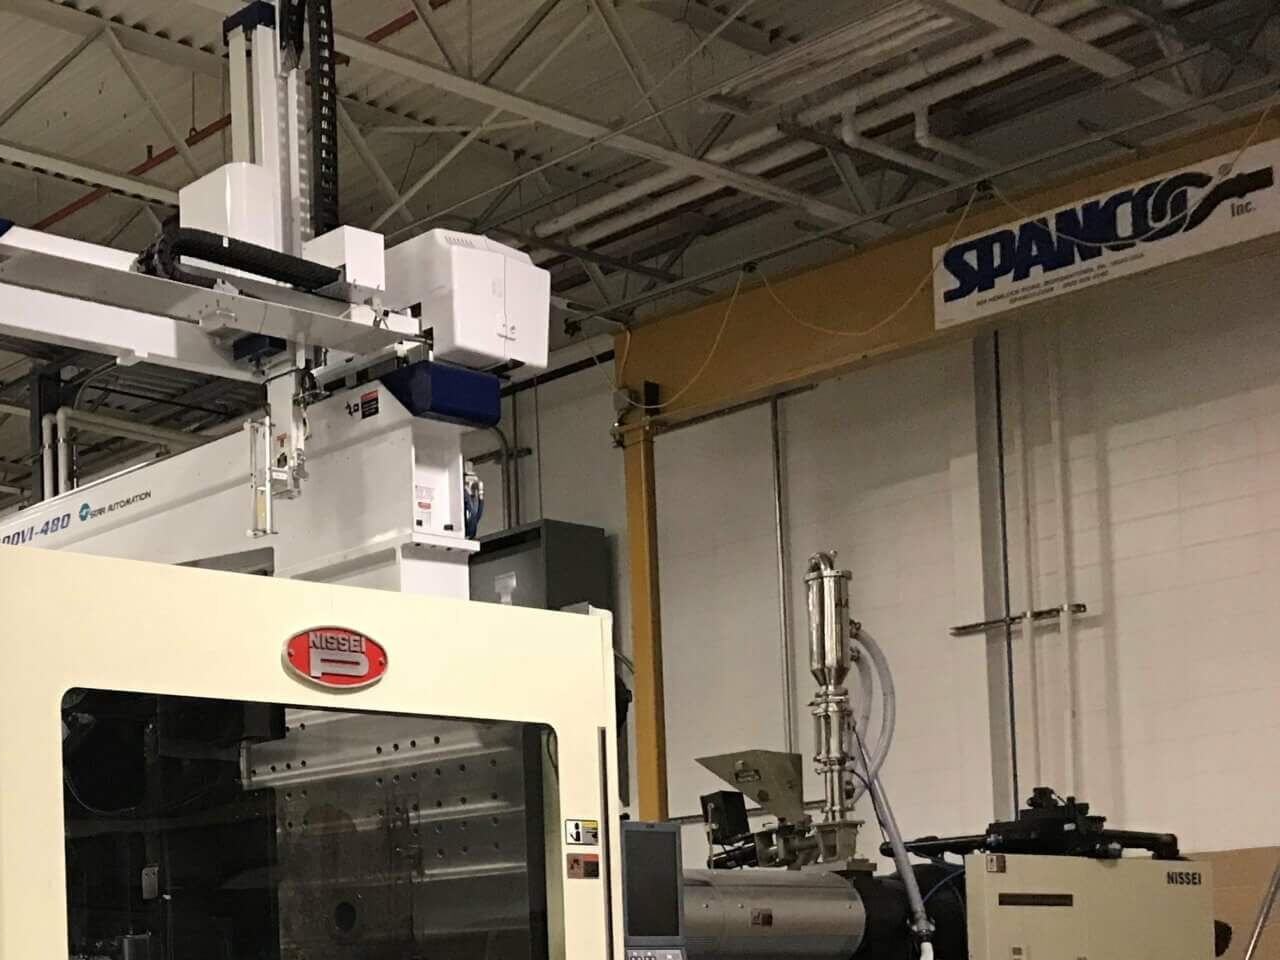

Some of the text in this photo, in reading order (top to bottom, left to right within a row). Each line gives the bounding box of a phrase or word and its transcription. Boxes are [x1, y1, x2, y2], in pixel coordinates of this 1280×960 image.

[1231, 201, 1256, 217] Inc.
[108, 490, 151, 512] AUTOMATION
[308, 631, 366, 653] NISSEI
[1167, 871, 1201, 885] NISSEI
